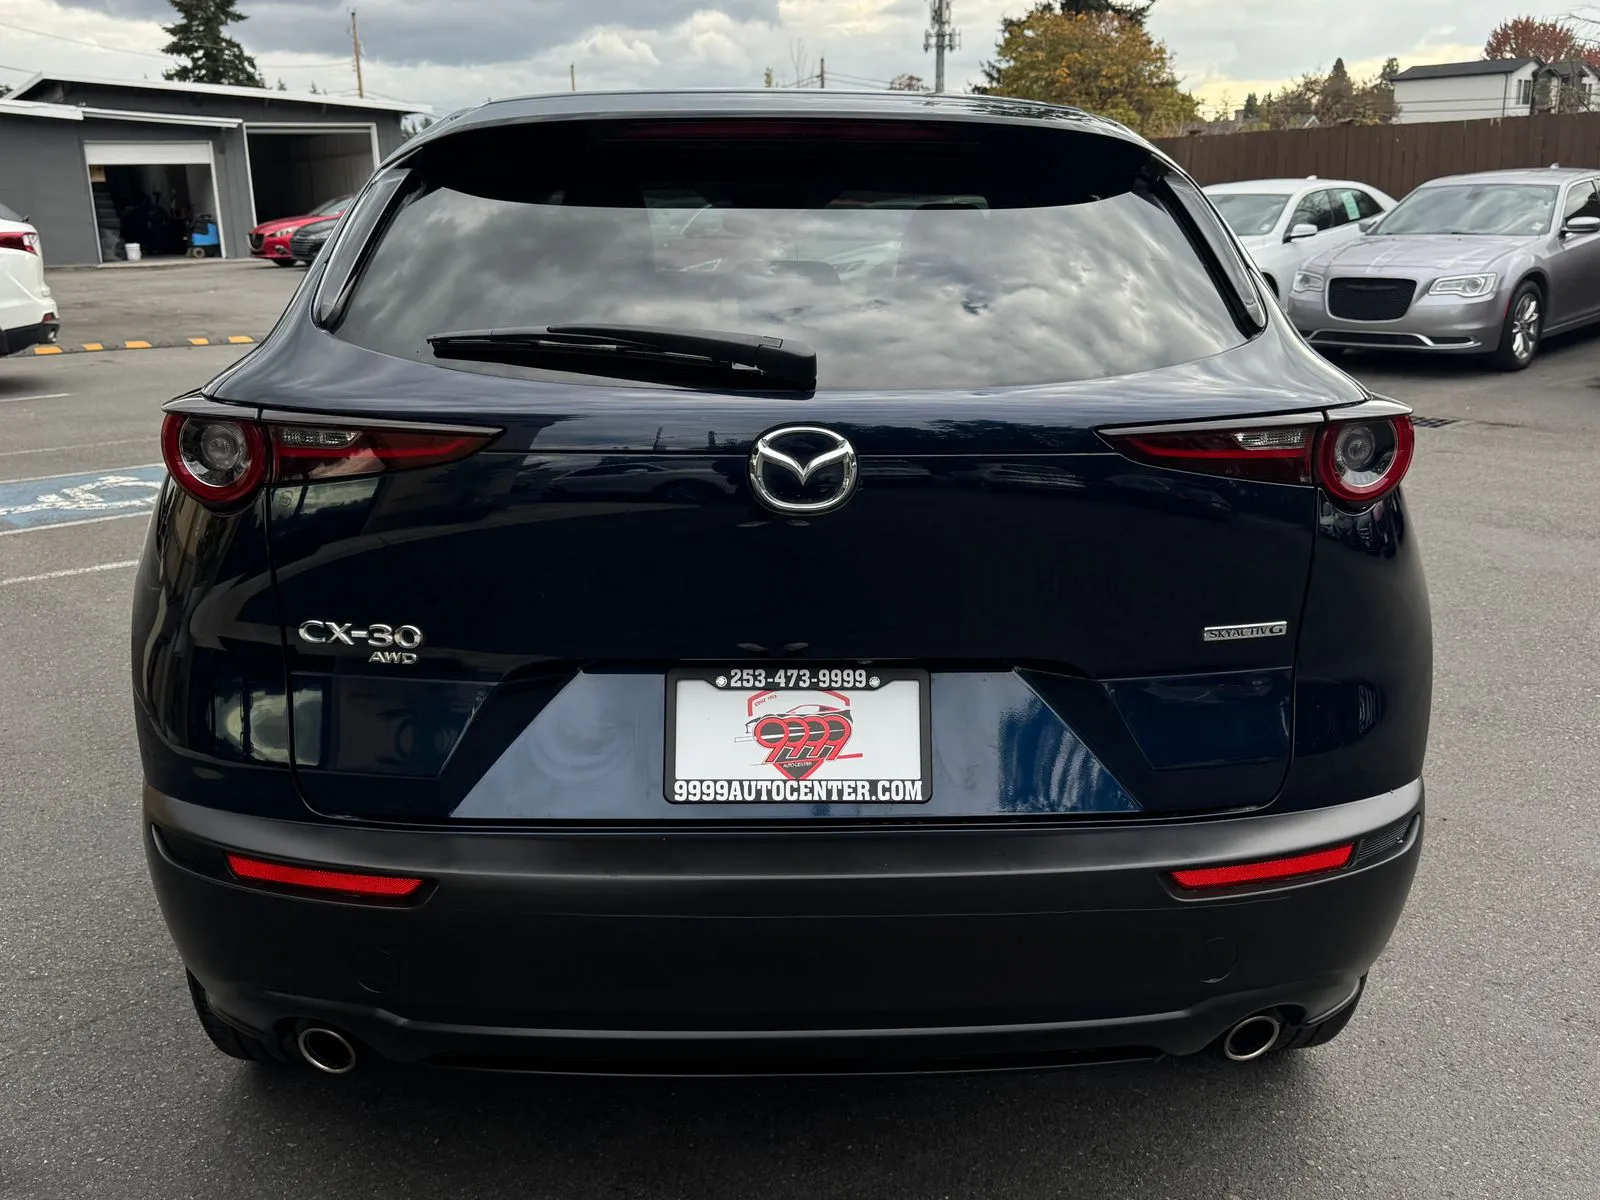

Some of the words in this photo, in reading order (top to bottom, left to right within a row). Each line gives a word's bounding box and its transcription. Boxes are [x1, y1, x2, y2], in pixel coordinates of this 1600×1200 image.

[298, 619, 423, 649] CX-30
[368, 651, 417, 664] AWD
[730, 669, 867, 688] 253-473-9999
[674, 780, 923, 801] 9999AUTOCENTER.COM
